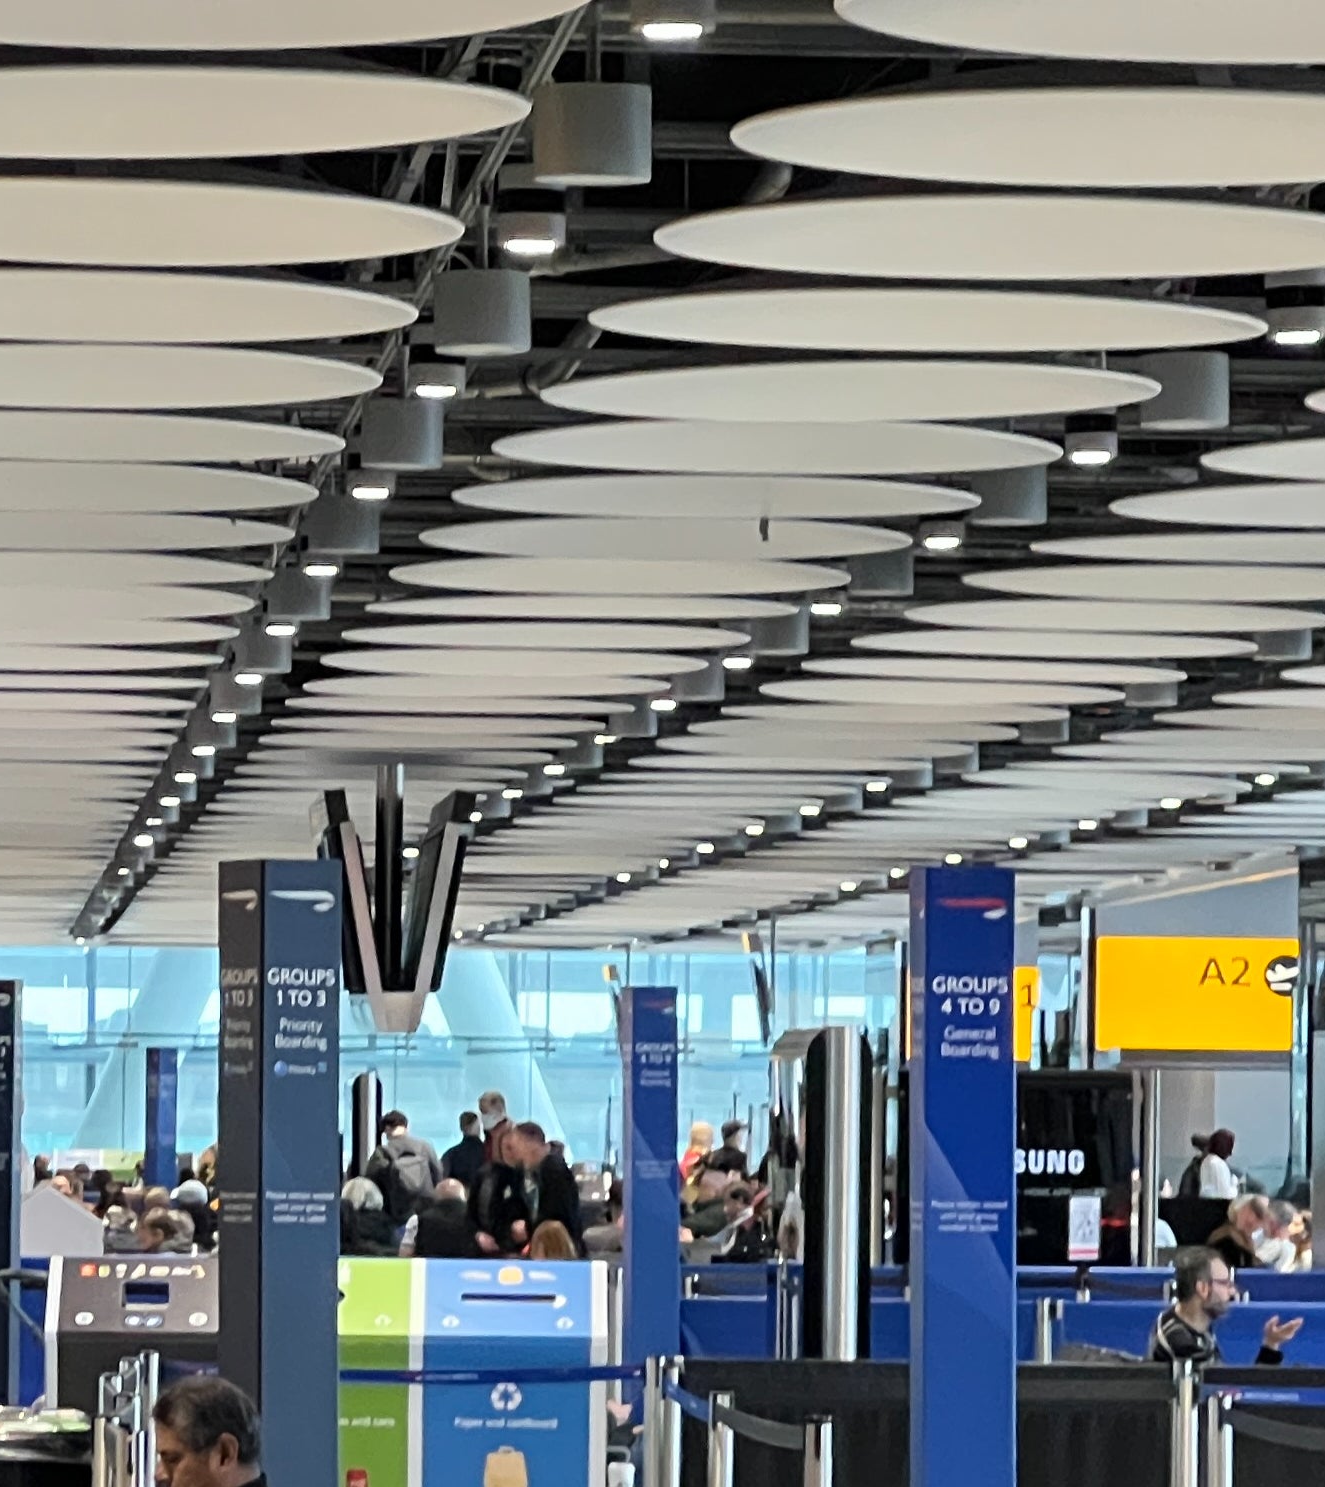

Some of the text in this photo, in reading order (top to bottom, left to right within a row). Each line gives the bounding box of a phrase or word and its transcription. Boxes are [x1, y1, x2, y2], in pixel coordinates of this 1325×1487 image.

[267, 967, 336, 987] GROUPS
[1199, 957, 1251, 987] A2
[932, 976, 1008, 995] GROUPS
[277, 989, 326, 1007] 1 TO 3
[941, 997, 1001, 1015] 4 TO 9
[279, 1017, 323, 1035] Priority
[944, 1025, 996, 1041] General
[275, 1033, 328, 1053] Boarding
[941, 1043, 999, 1060] Boarding
